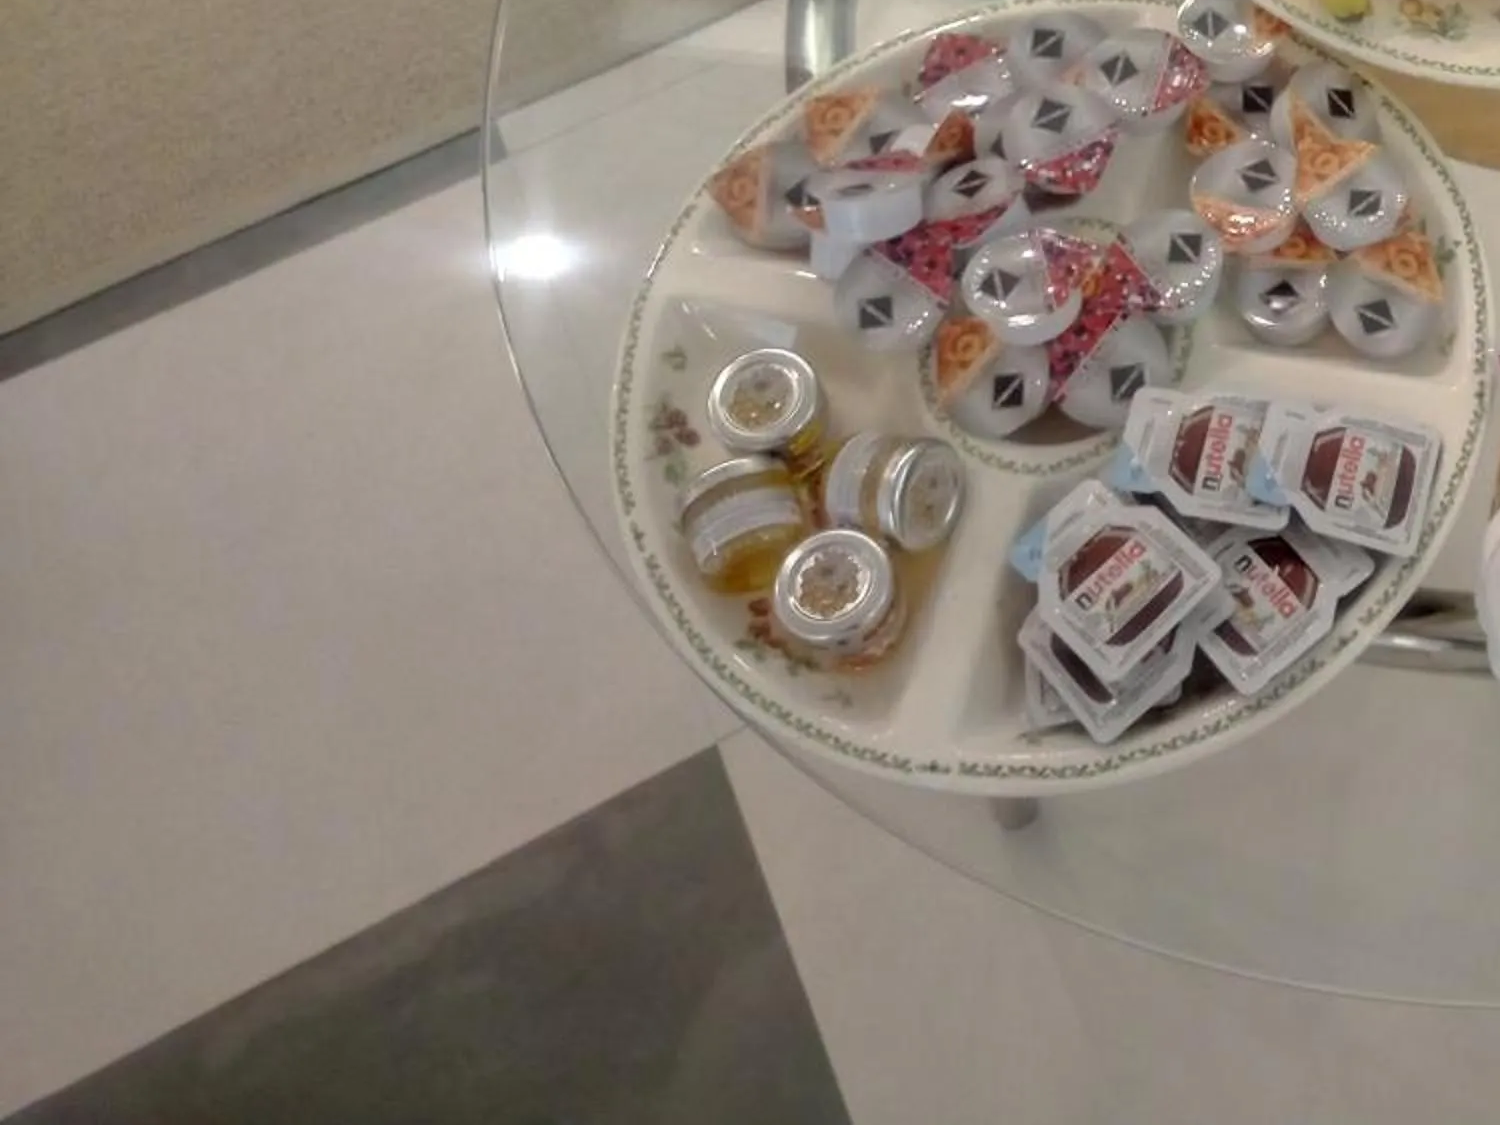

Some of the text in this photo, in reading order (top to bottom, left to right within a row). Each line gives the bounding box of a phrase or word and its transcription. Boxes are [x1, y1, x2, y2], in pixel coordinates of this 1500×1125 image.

[1202, 411, 1234, 493] nutella
[1335, 434, 1367, 511] nutella
[1074, 538, 1149, 612] nutella
[1234, 554, 1301, 621] nutella
